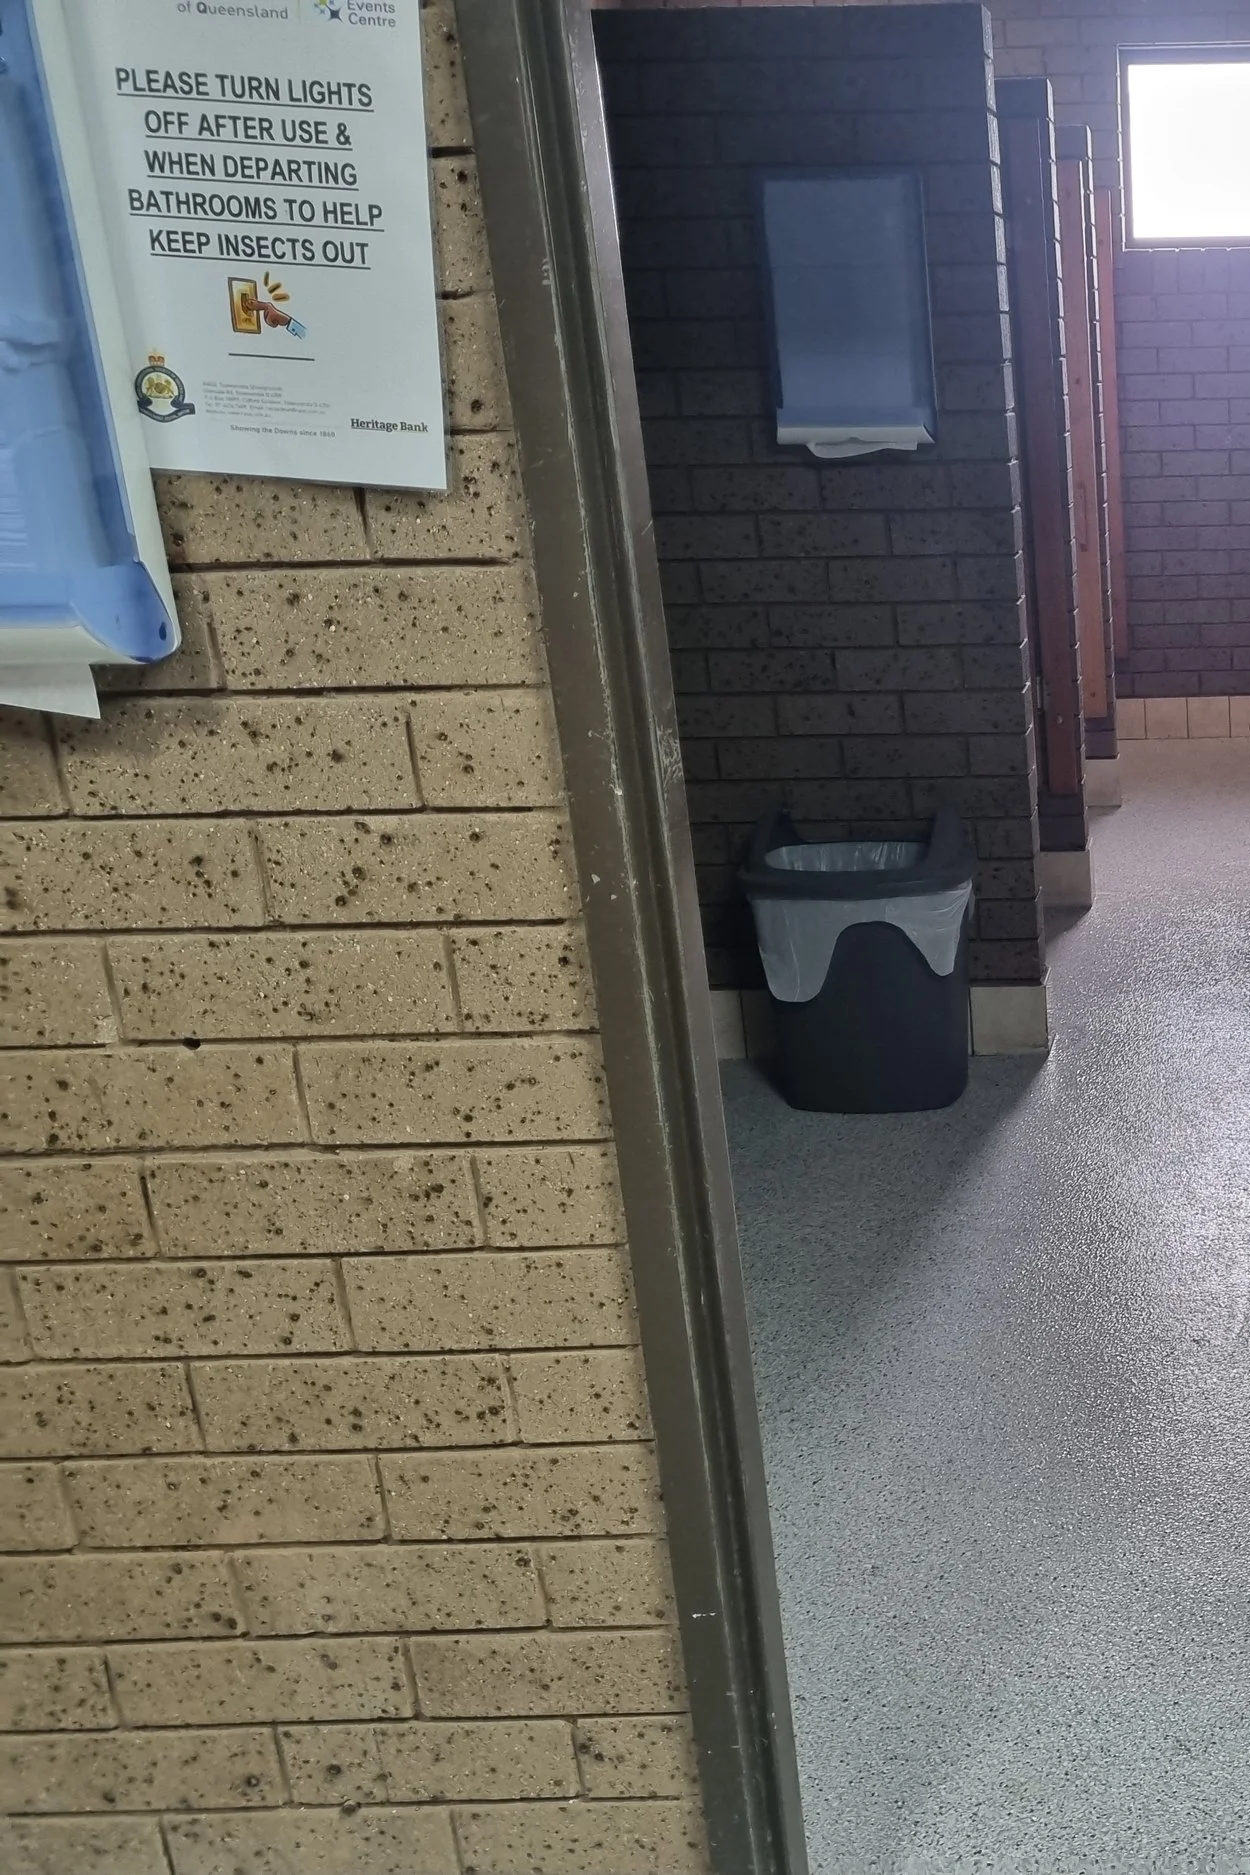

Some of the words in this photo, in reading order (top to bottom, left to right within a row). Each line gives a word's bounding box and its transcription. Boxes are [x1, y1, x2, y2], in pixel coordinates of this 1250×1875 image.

[177, 1, 192, 13] of
[196, 1, 289, 20] Queensland
[347, 0, 396, 14] Events
[348, 13, 396, 27] Centre
[115, 67, 210, 96] PLEASE
[215, 73, 281, 102] TURN
[288, 78, 373, 107] LIGHTS
[144, 110, 190, 134] OFF
[198, 113, 275, 141] AFTER
[281, 118, 328, 144] USE
[336, 122, 352, 146] &
[144, 150, 216, 177] WHEN
[223, 154, 358, 186] DEPARTING
[128, 188, 278, 220] BATHROOMS
[284, 198, 316, 222] TO
[323, 201, 383, 227] HELP
[149, 229, 210, 254] KEEP
[217, 233, 316, 262] INSECTS
[321, 240, 369, 265] OUT
[230, 424, 260, 434] Showing
[262, 425, 273, 434] the
[274, 427, 297, 436] Downs
[299, 428, 317, 437] since
[351, 418, 398, 432] Heritage
[400, 421, 428, 432] Bank
